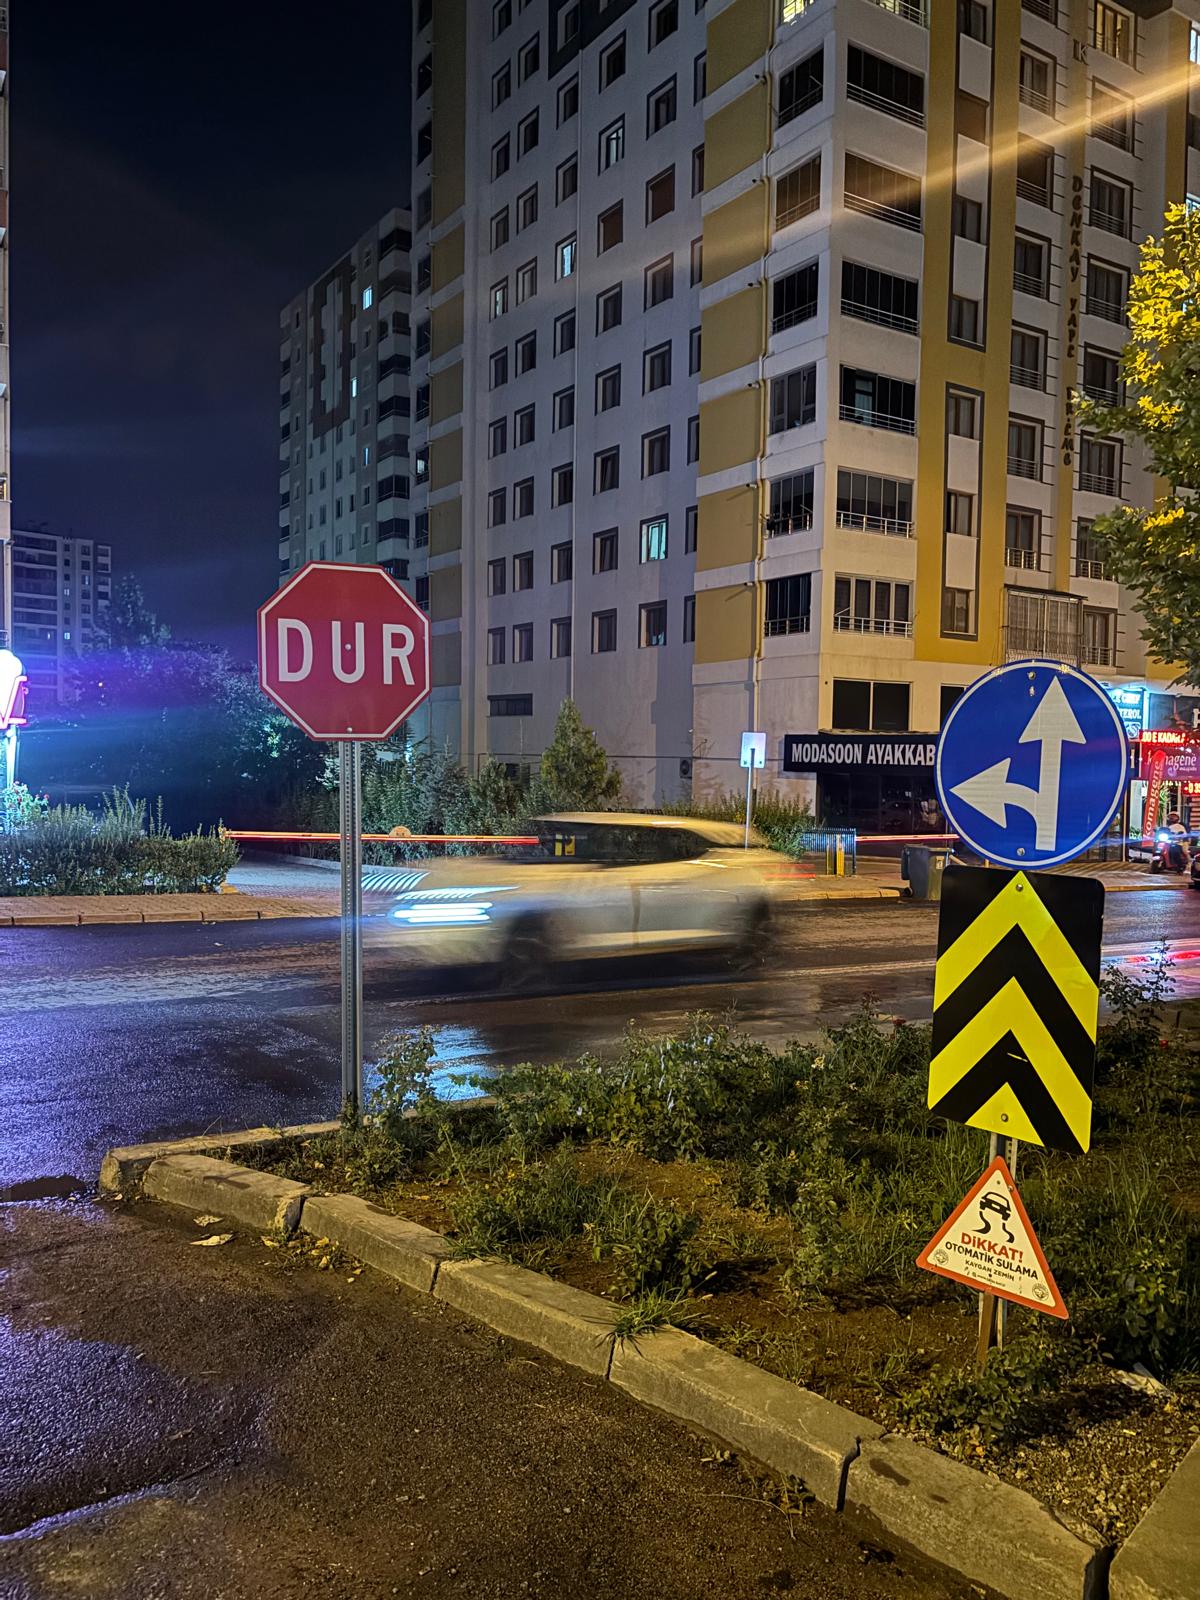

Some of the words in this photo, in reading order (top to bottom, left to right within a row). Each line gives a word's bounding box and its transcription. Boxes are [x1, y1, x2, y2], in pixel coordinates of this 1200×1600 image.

[277, 618, 416, 686] DUR
[791, 743, 863, 764] MODASOON
[866, 744, 936, 766] AYAKKAB
[945, 1241, 994, 1265] OTOMATİK
[996, 1258, 1039, 1280] SULAMA
[961, 1232, 1024, 1263] DİKKAT!
[965, 1259, 992, 1273] KAYGAN
[993, 1269, 1015, 1282] ZEMİN
